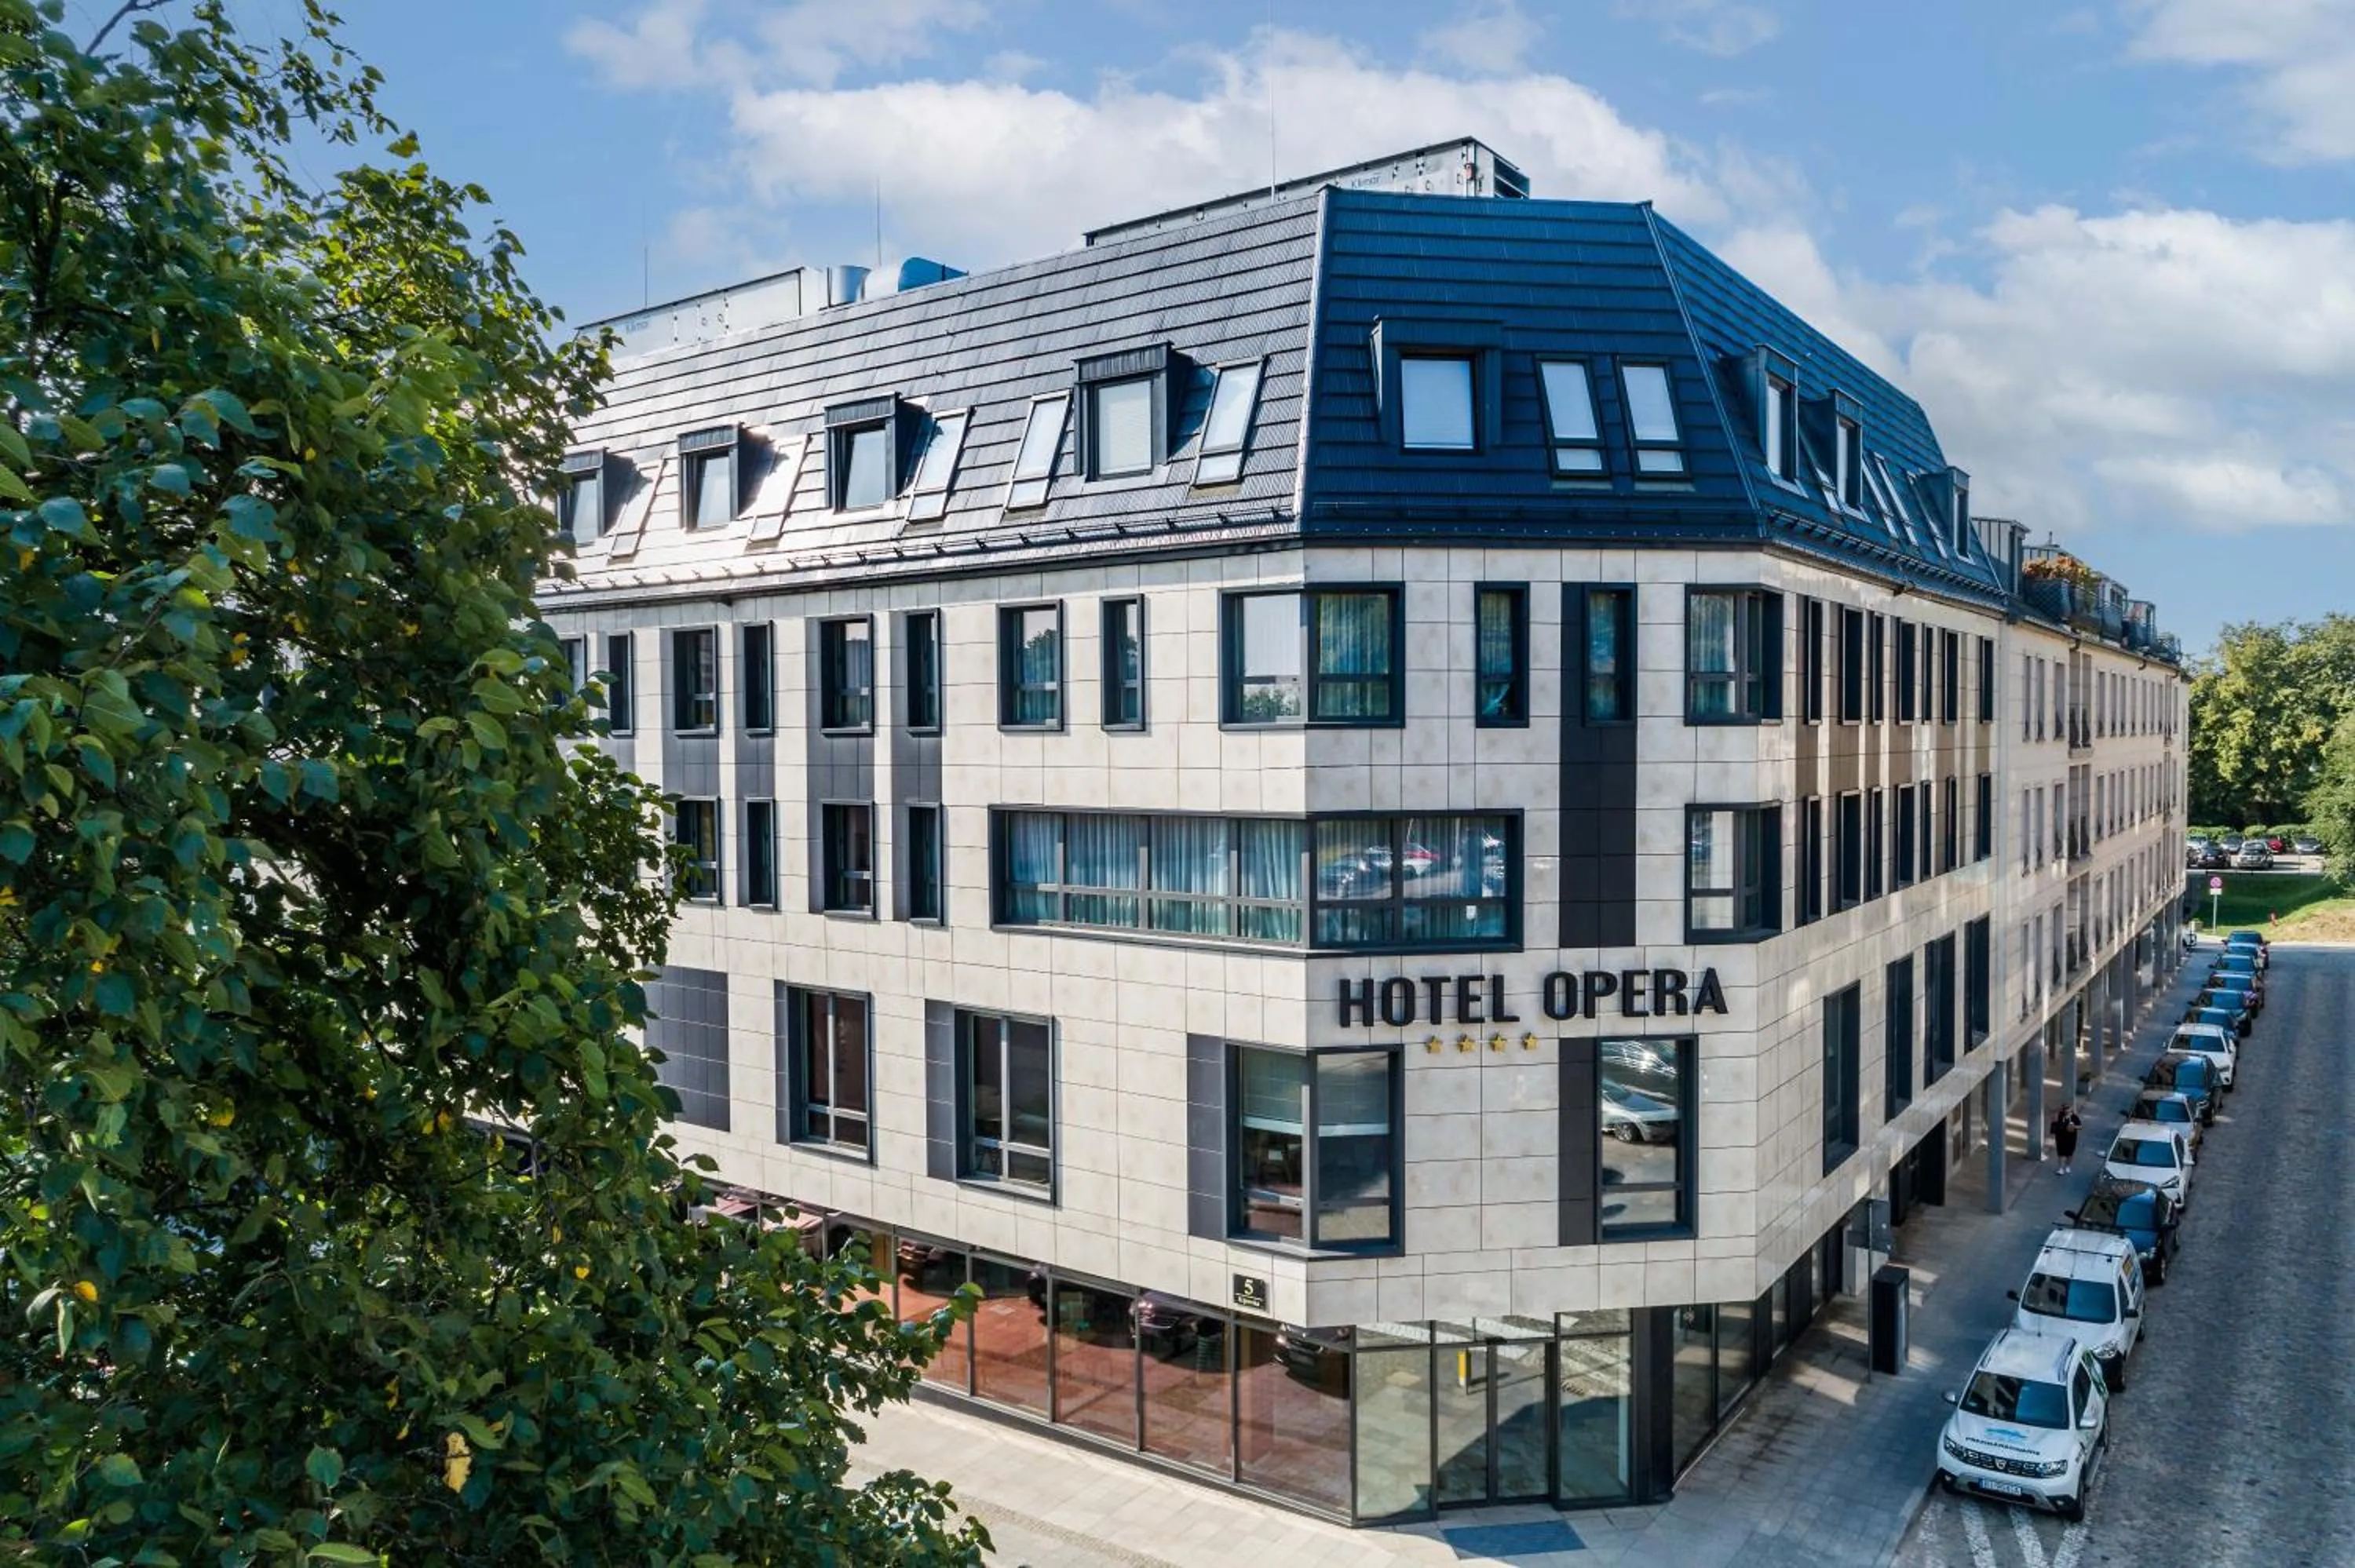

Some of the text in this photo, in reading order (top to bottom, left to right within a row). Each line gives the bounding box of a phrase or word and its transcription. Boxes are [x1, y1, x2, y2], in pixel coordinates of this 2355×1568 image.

[1338, 967, 1729, 1027] HOTEL OPERA
[1243, 1278, 1254, 1296] 5
